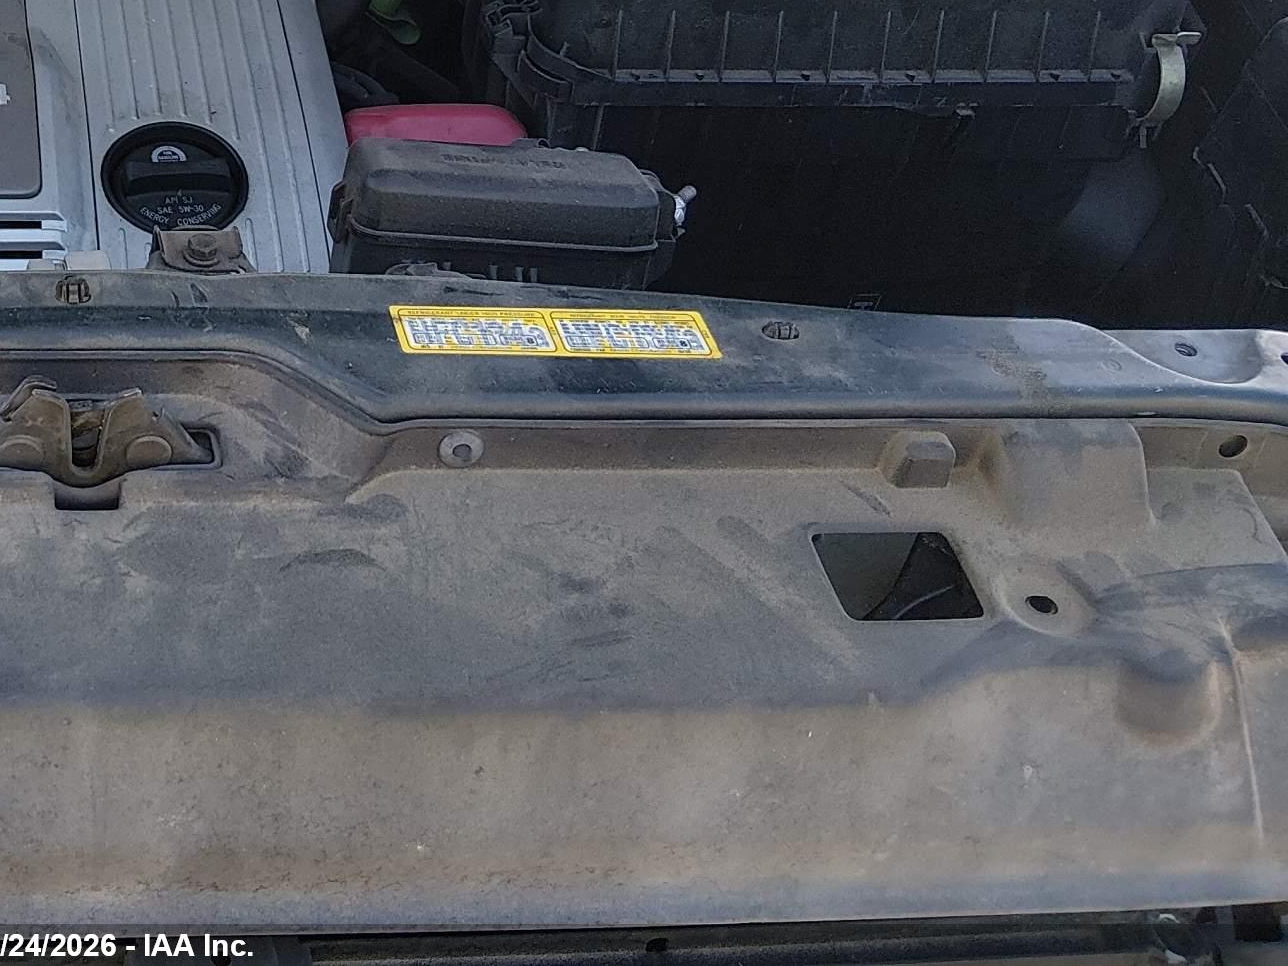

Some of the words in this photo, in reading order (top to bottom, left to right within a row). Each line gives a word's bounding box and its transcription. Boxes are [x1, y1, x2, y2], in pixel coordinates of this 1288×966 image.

[165, 196, 179, 204] API
[157, 206, 173, 214] SAE
[178, 205, 204, 214] 5W-30
[140, 206, 170, 225] ENERGY
[176, 203, 222, 226] CONSERVING
